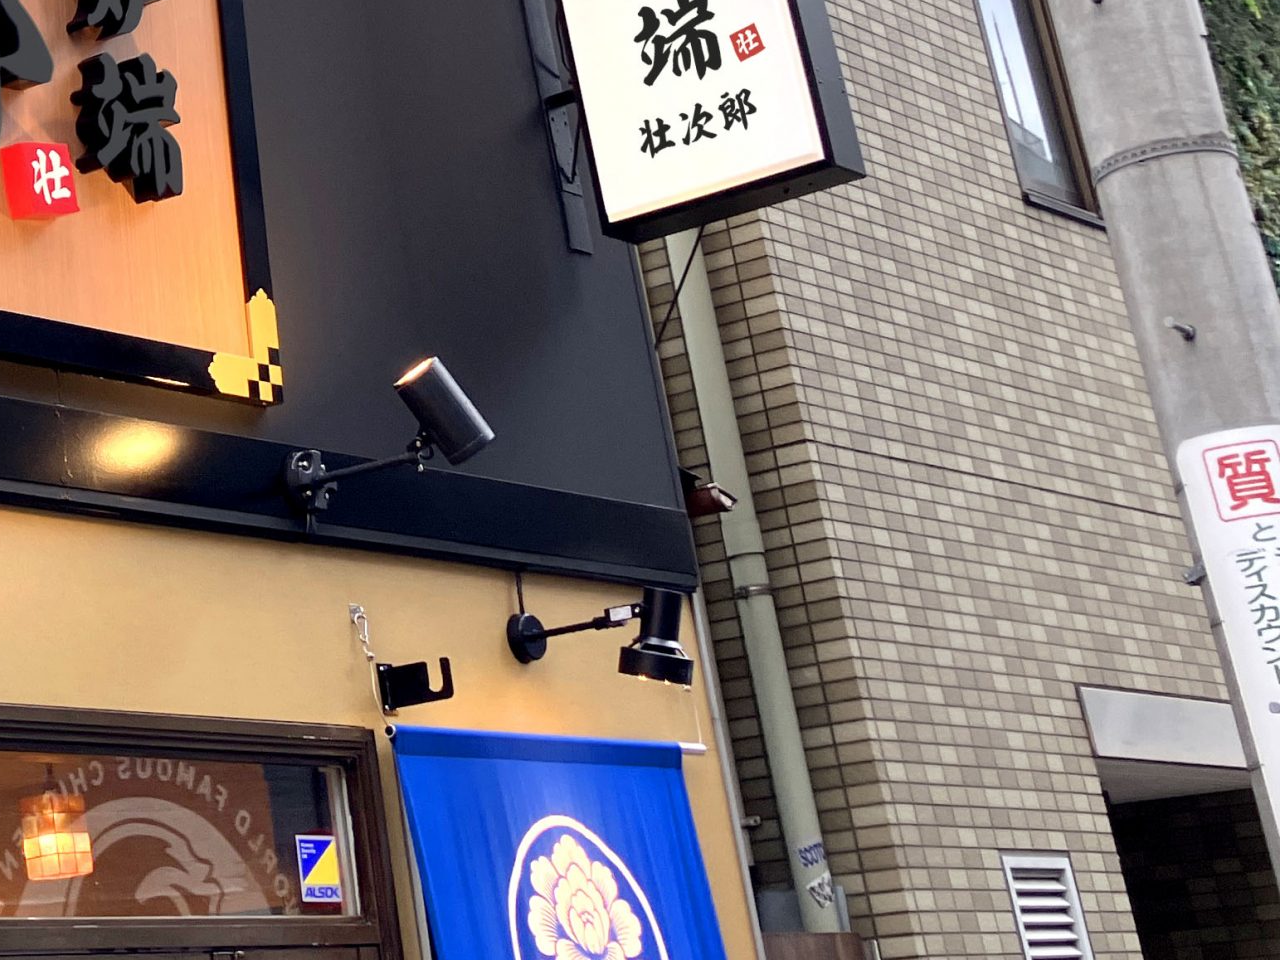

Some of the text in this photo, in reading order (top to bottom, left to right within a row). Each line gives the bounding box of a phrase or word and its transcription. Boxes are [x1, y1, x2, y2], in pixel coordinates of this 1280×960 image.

[733, 27, 762, 59] 壮
[639, 88, 757, 158] 壮次郎
[32, 148, 72, 205] 壮
[1217, 449, 1280, 510] 質
[304, 886, 340, 899] ALSOK
